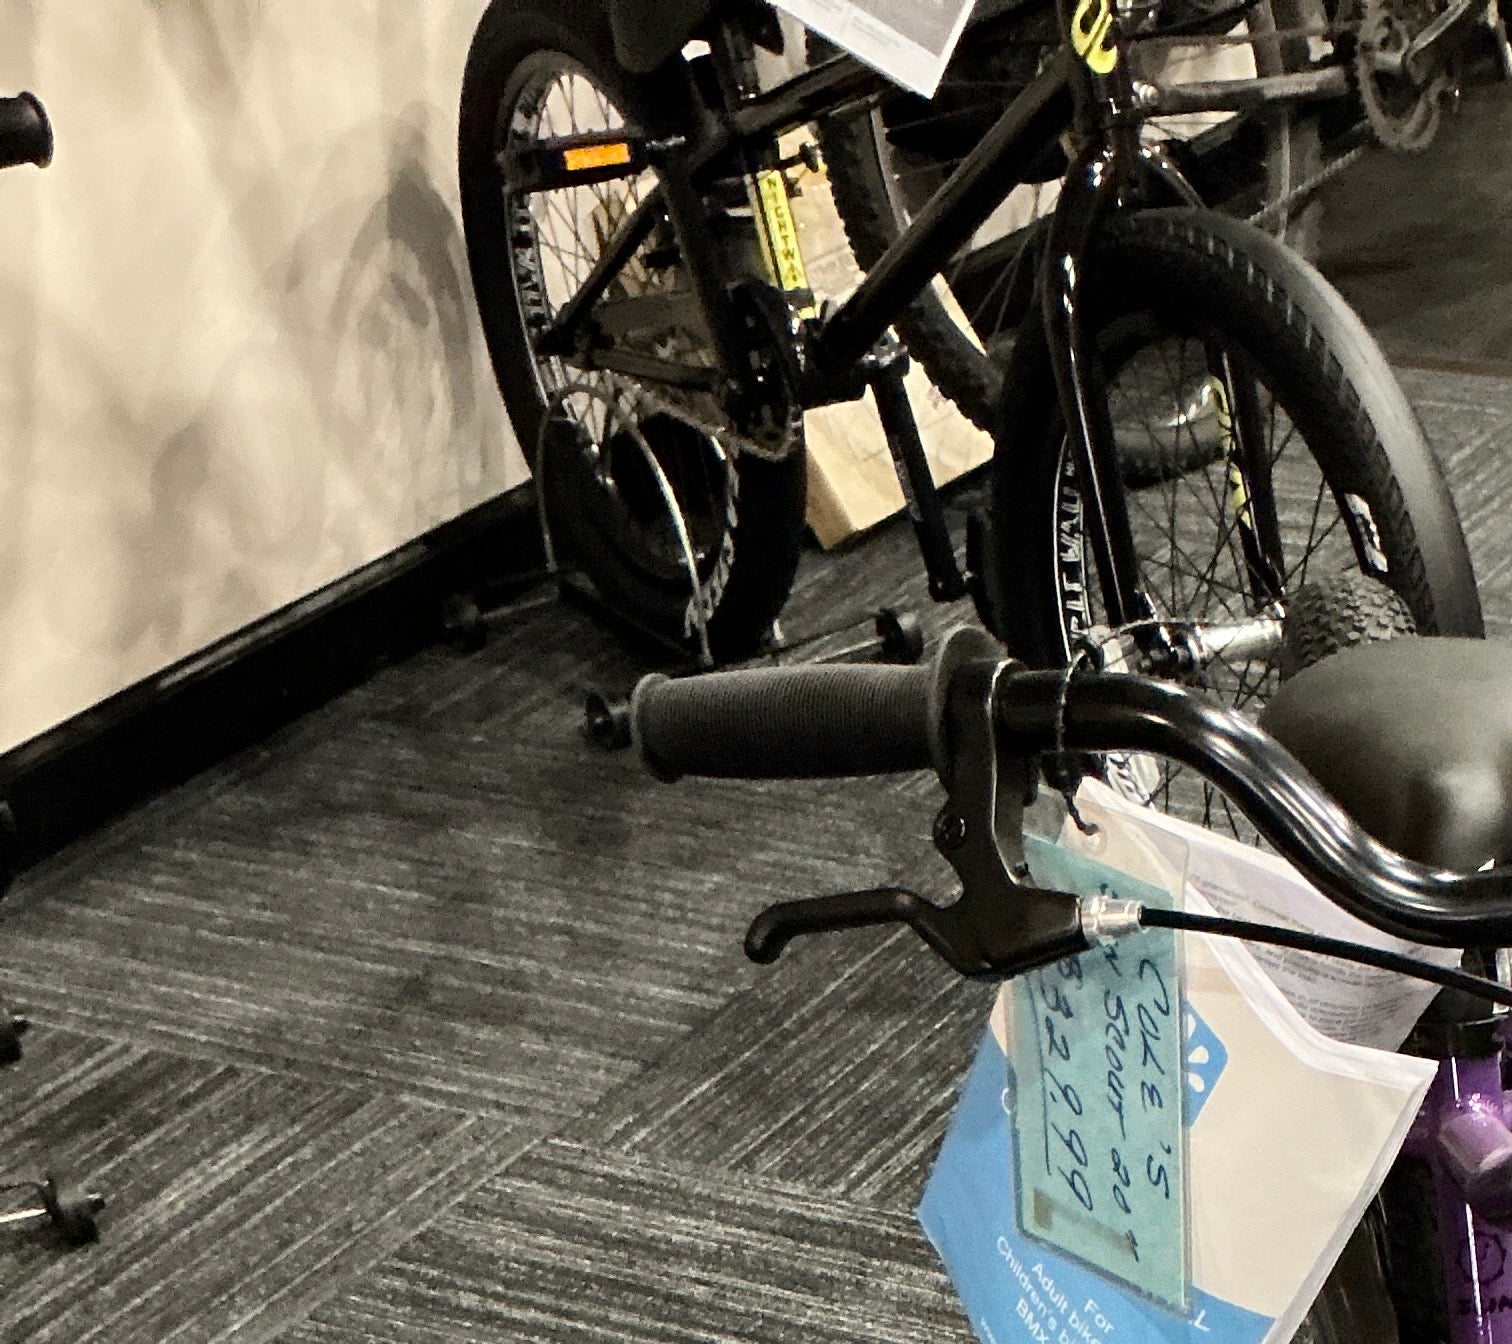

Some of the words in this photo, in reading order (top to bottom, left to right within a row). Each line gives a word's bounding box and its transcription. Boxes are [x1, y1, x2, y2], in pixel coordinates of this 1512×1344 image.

[1103, 988, 1130, 1140] SCOUT
[996, 1235, 1058, 1331] Children's
[1031, 1262, 1069, 1315] Adult
[1083, 1298, 1115, 1334] For
